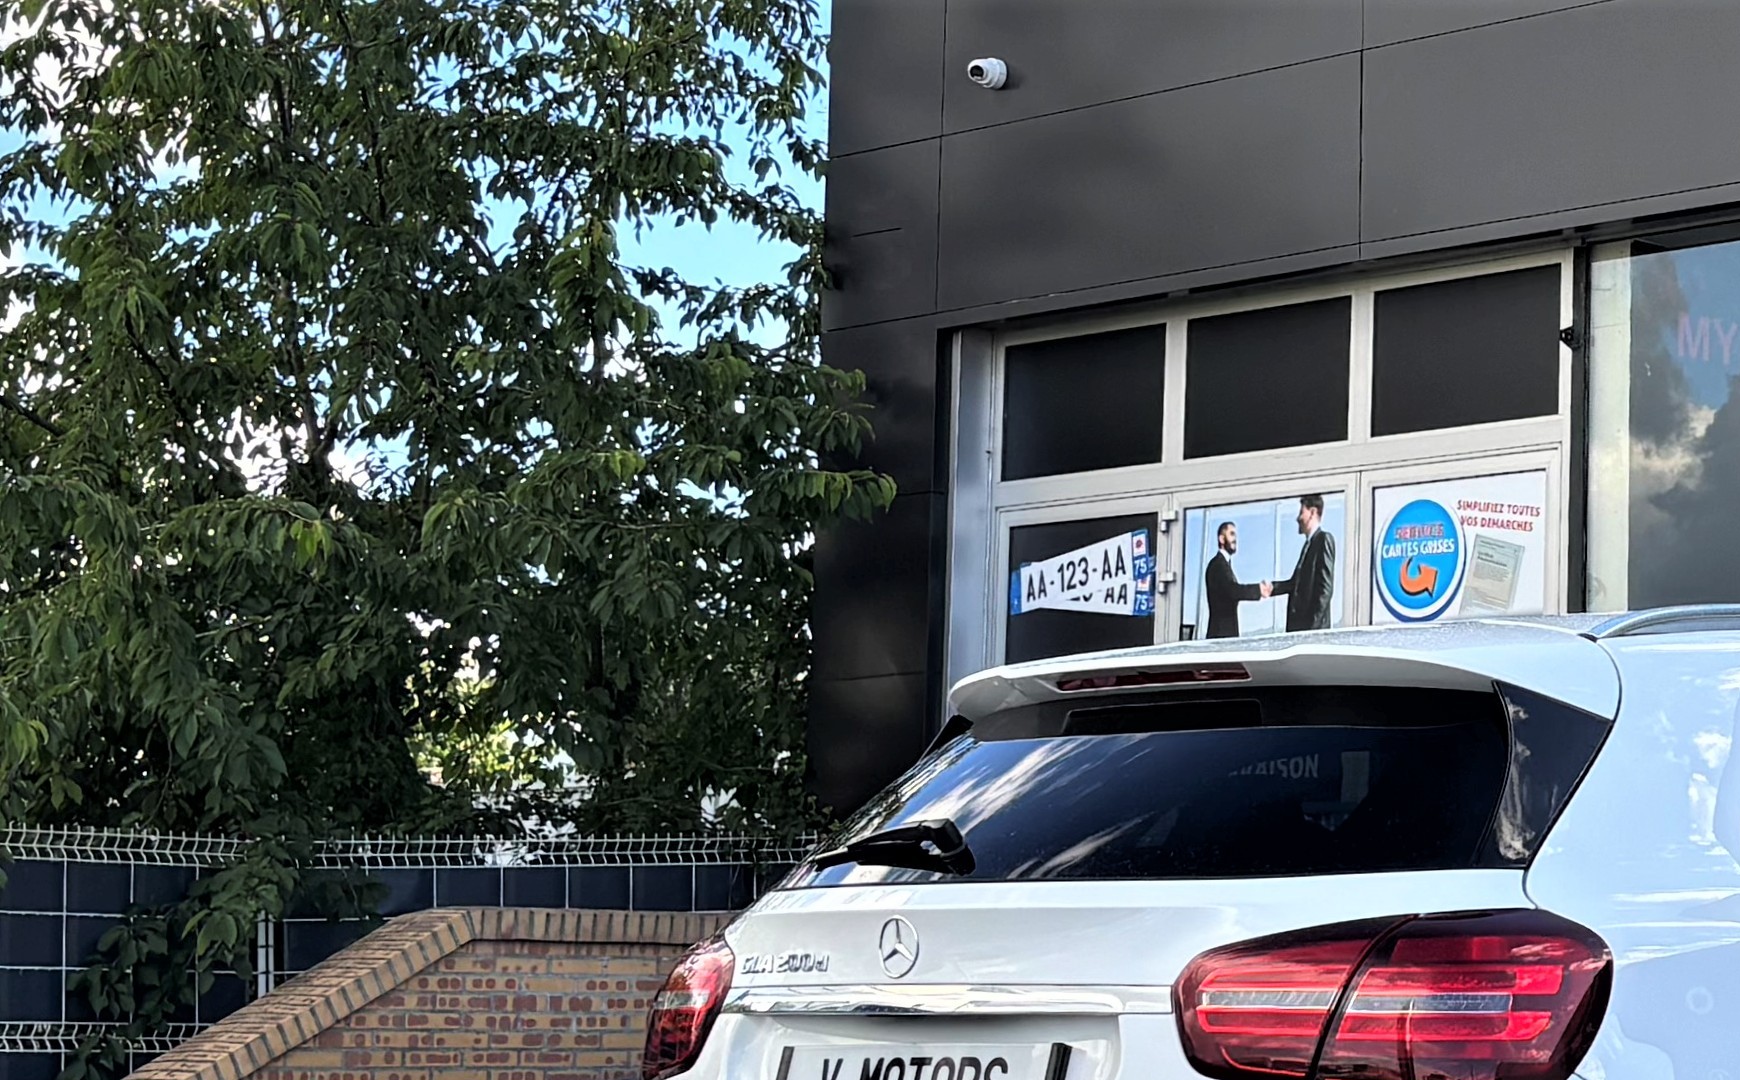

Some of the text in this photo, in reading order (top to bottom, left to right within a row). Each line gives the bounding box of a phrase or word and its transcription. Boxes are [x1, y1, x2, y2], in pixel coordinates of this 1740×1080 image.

[1677, 312, 1739, 366] MY
[1457, 500, 1540, 518] SIMPLIFIEZ TOUTES
[1460, 515, 1478, 527] VOS
[1383, 538, 1456, 559] CARTES GRISES
[1134, 556, 1148, 576] 75
[1136, 594, 1148, 611] 75
[741, 953, 775, 975] GLA
